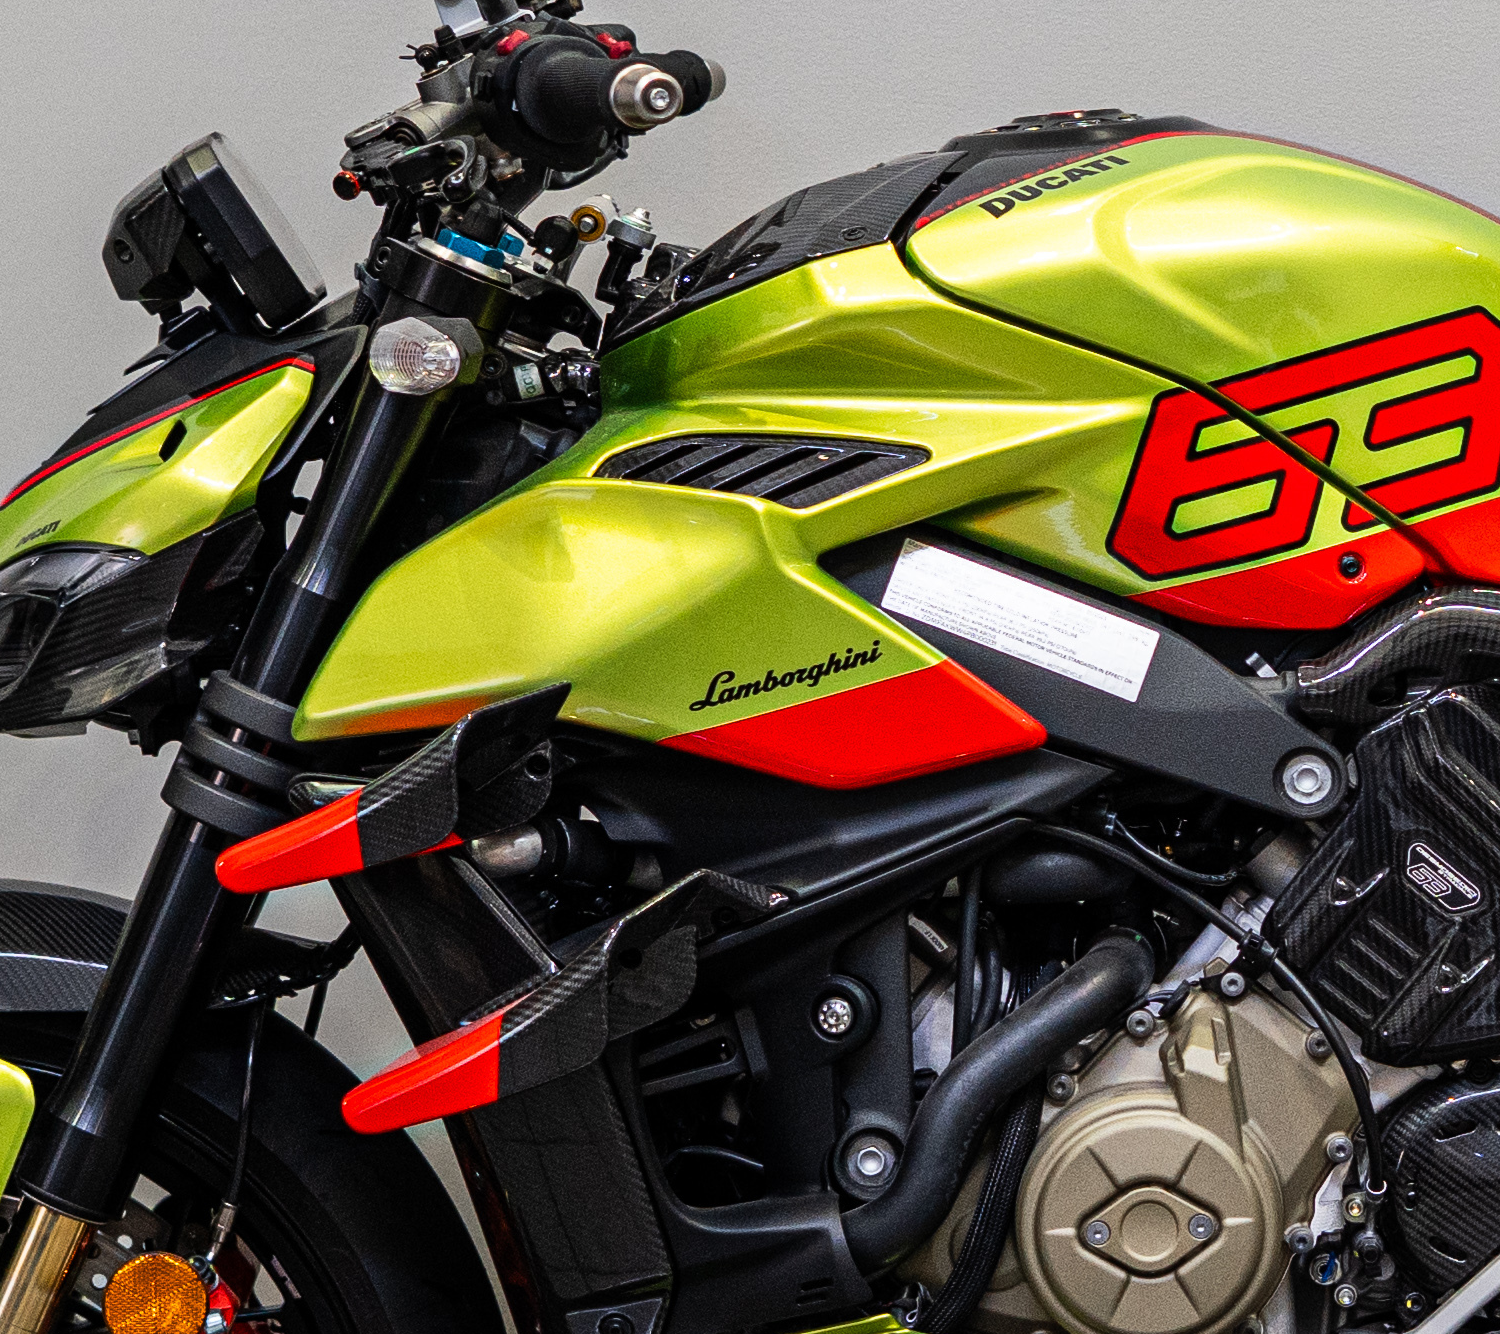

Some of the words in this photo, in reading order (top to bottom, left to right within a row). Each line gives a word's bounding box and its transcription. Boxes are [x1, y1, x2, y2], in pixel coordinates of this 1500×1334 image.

[978, 155, 1130, 219] DUCATI
[15, 519, 62, 549] DUCATI
[689, 639, 883, 712] Lamborghini
[1407, 862, 1451, 898] 63
